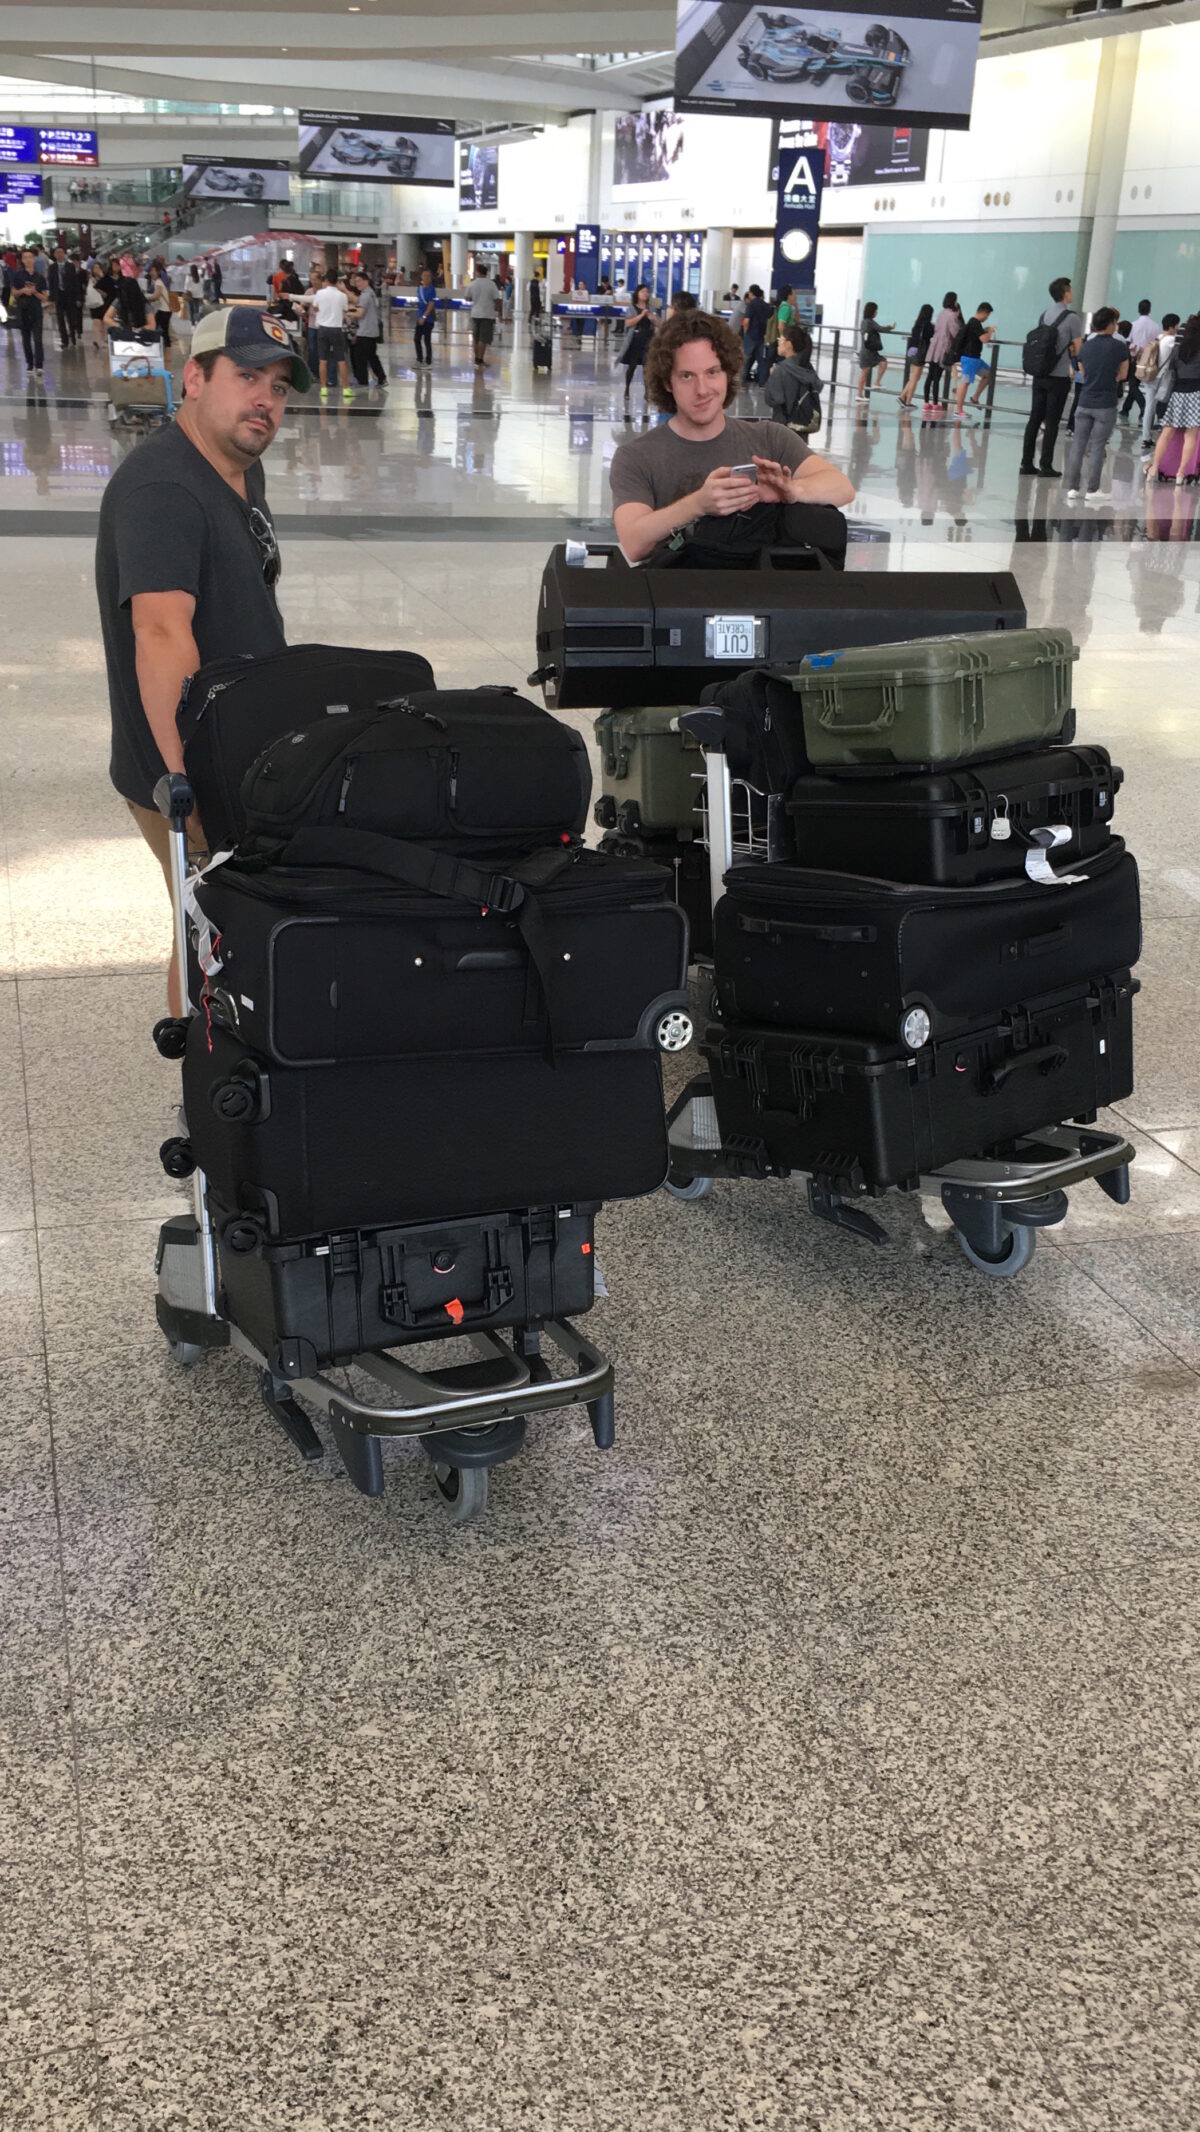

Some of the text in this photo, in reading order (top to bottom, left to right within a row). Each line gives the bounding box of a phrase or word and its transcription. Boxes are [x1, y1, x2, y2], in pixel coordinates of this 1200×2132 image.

[784, 155, 817, 194] A
[604, 235, 610, 243] 7
[644, 234, 652, 243] 4
[660, 234, 668, 244] 3
[675, 233, 683, 243] 2
[693, 233, 699, 243] 1
[717, 623, 745, 634] CREATE
[722, 634, 749, 653] CUT
